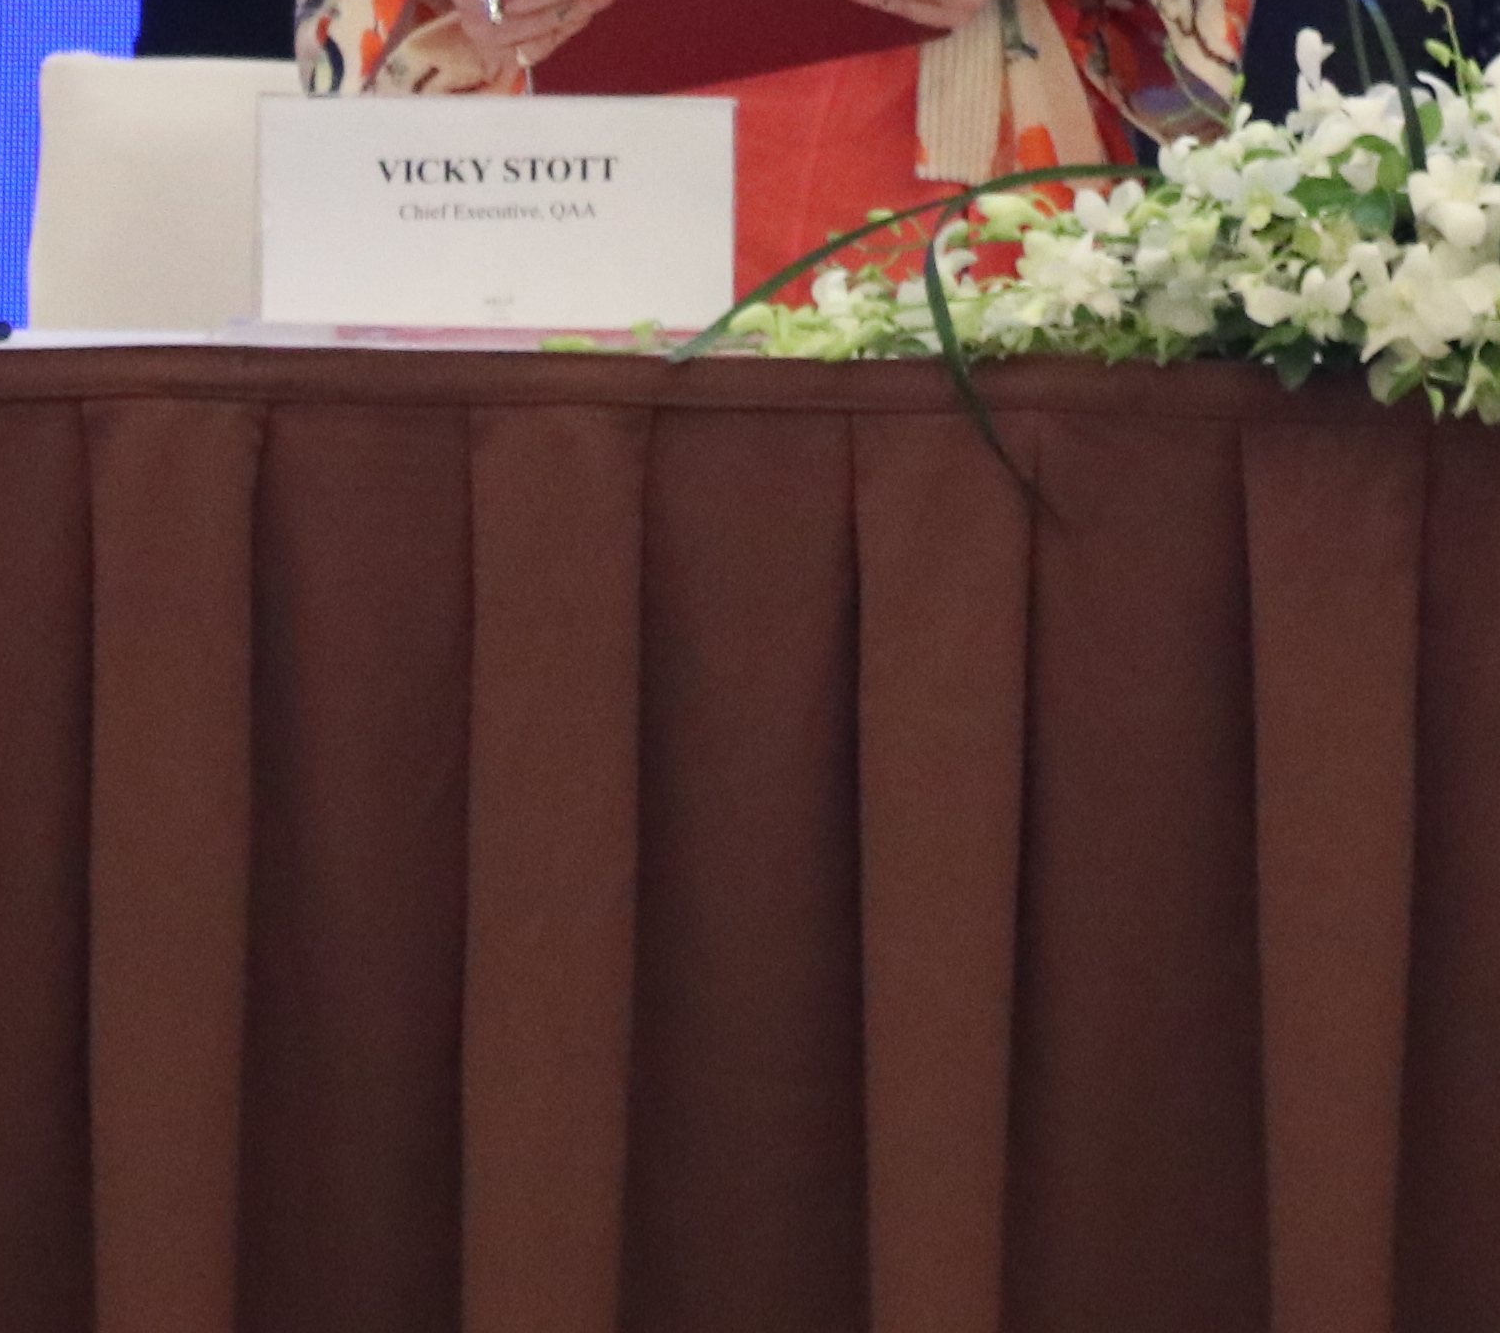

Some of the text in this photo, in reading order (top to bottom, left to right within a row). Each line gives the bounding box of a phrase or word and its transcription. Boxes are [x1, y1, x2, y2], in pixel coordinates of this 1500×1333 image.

[378, 156, 620, 184] VICKY STOTT
[399, 200, 598, 222] Chief Executive, QAA
